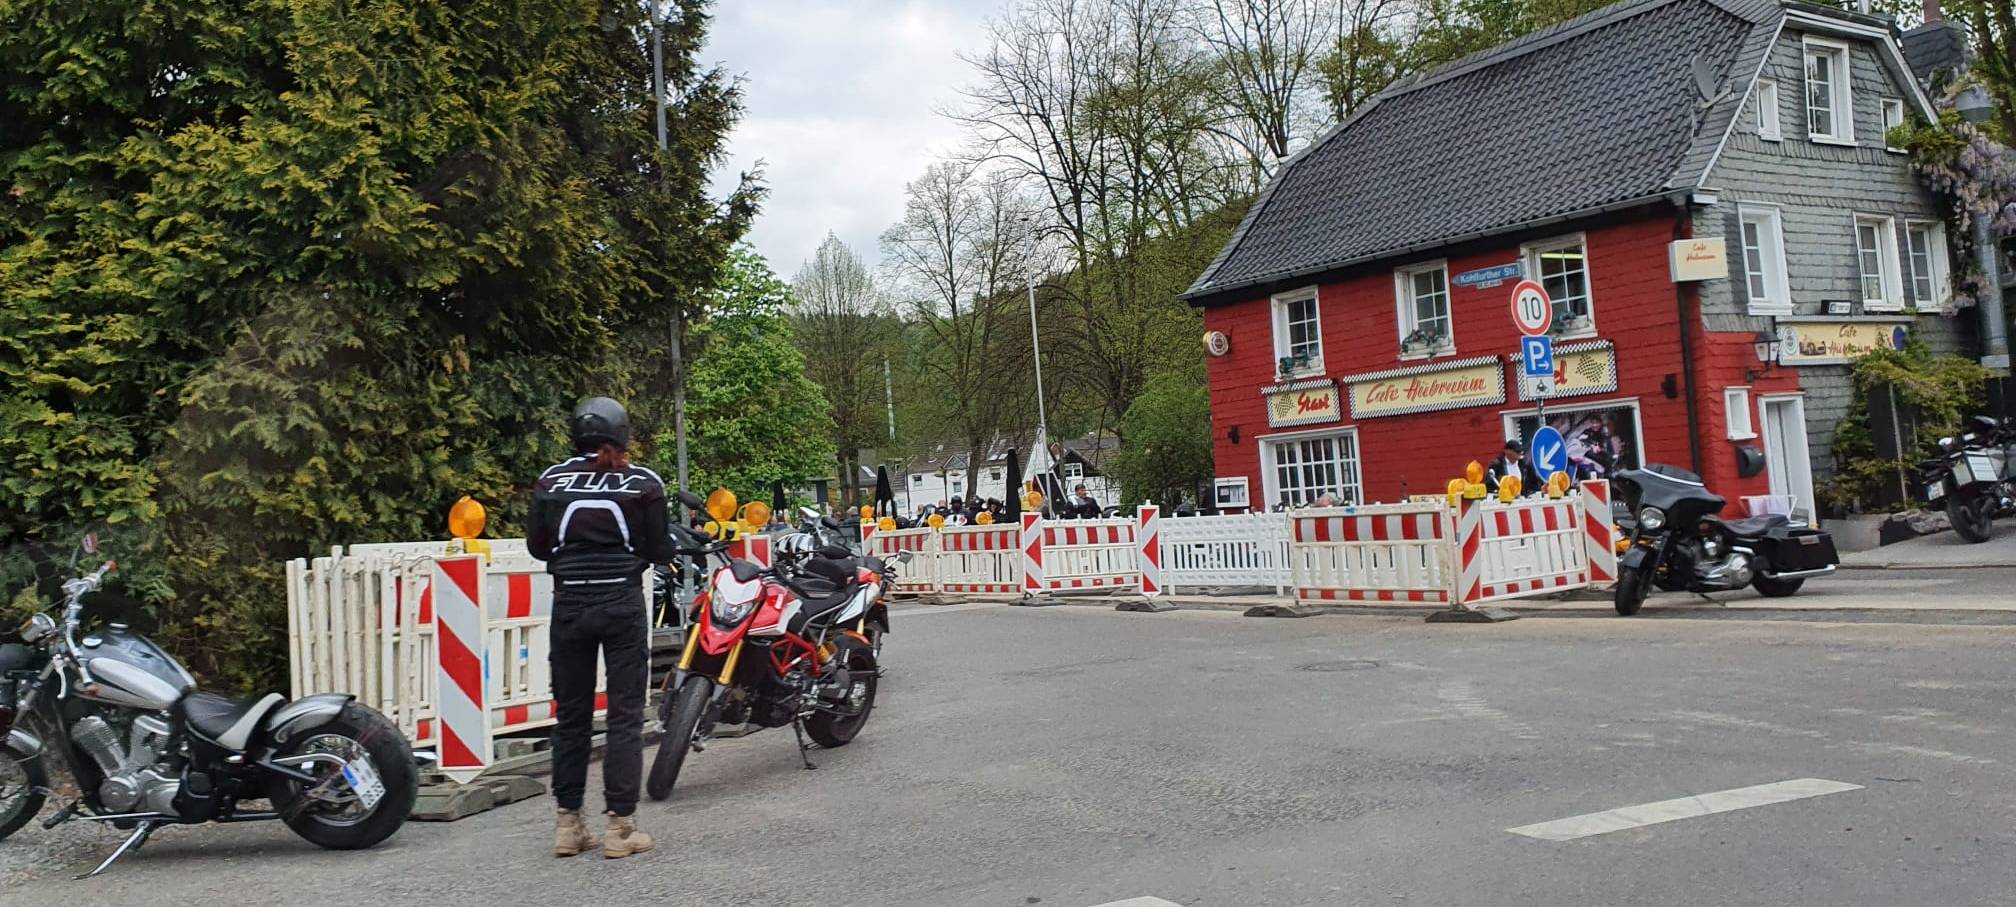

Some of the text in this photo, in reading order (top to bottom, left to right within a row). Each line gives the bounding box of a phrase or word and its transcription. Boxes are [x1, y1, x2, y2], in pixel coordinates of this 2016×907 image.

[1521, 296, 1542, 321] 10
[1528, 340, 1545, 371] P
[1297, 391, 1330, 415] Start
[546, 471, 647, 494] FLM
